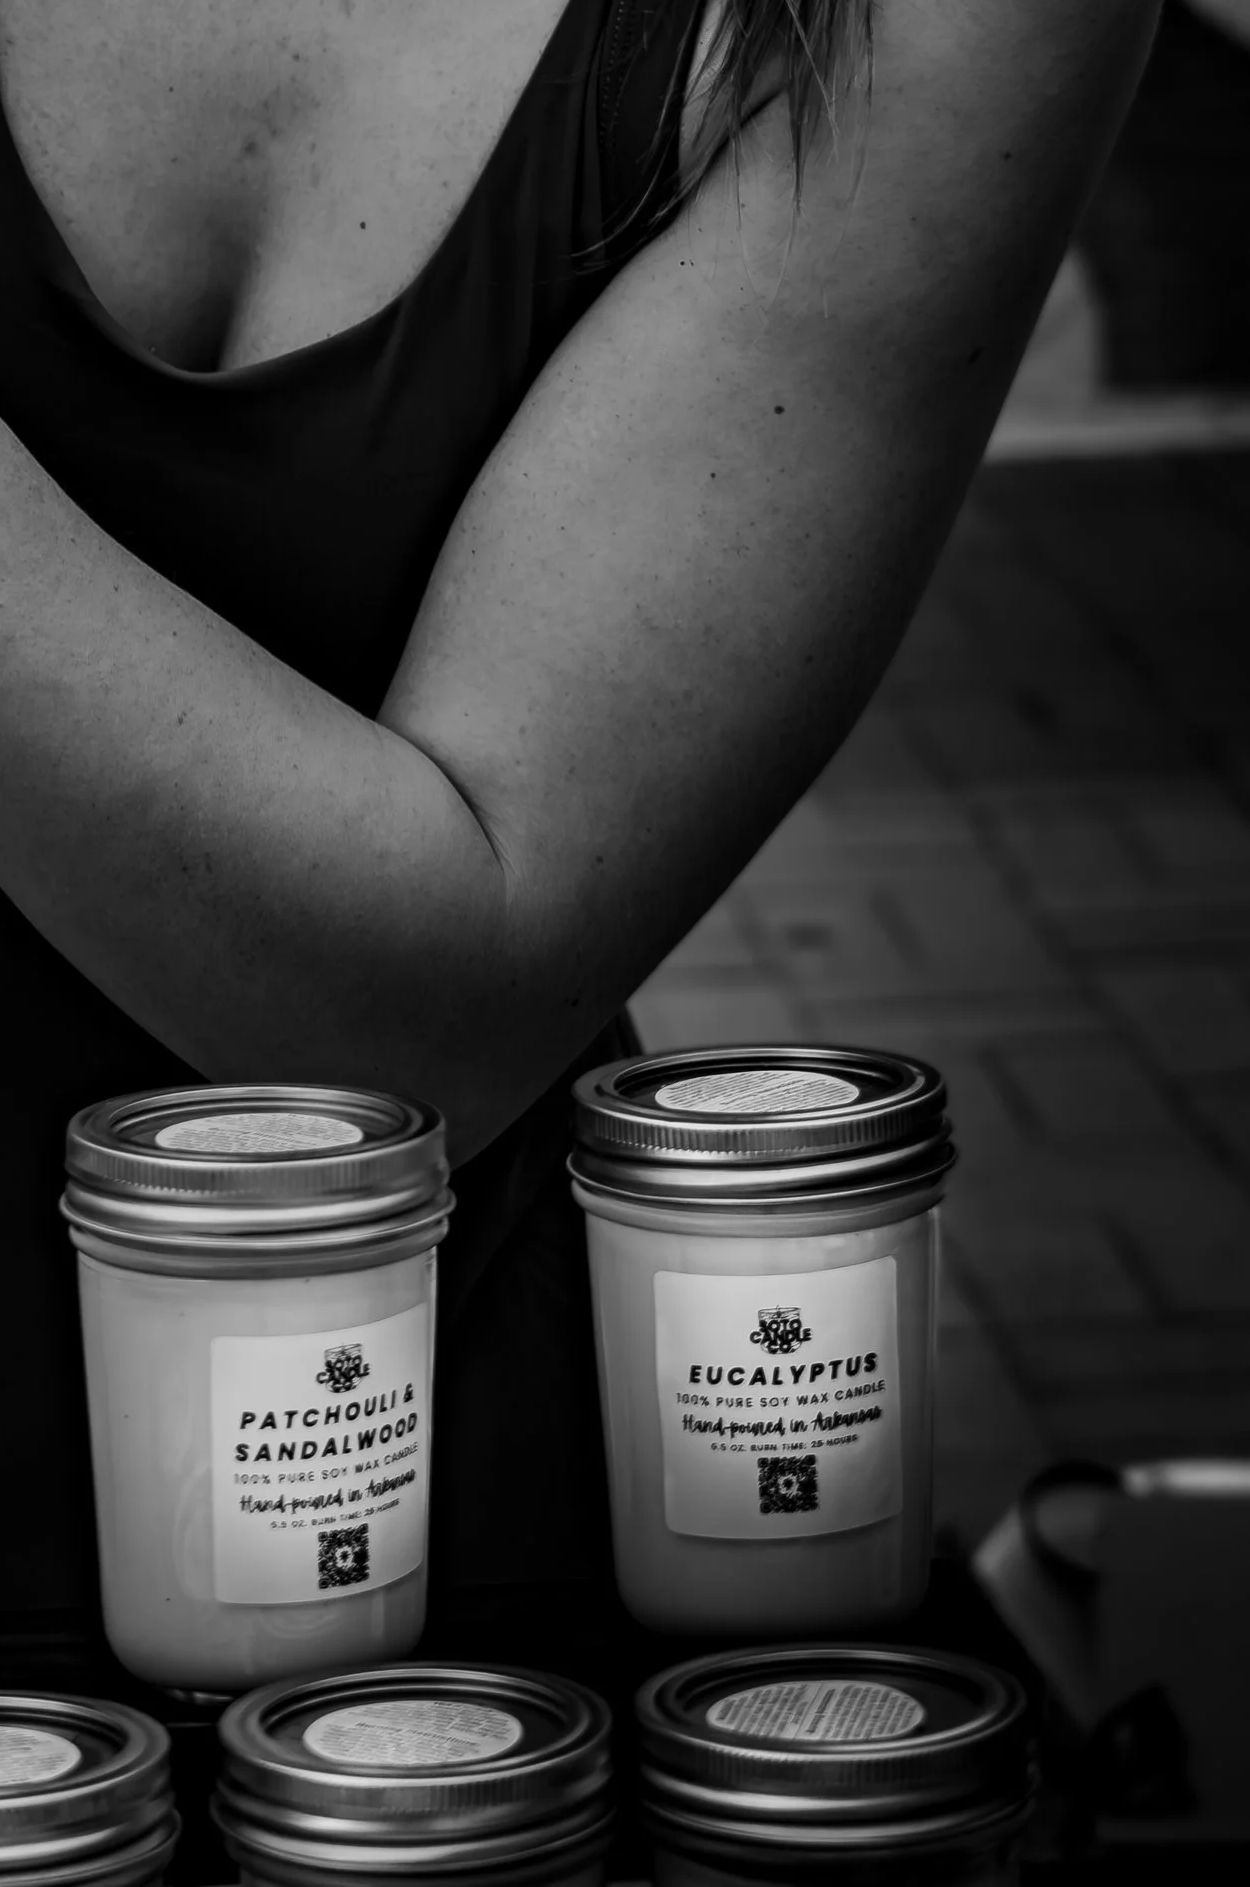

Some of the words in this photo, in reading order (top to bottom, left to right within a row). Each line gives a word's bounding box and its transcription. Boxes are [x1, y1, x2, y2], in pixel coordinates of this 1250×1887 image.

[688, 1352, 878, 1385] EUCALYPTUS
[239, 1389, 397, 1430] PATCHOULI
[403, 1382, 414, 1403] &
[677, 1392, 710, 1406] 100%
[716, 1397, 753, 1408] PURE
[760, 1397, 789, 1408] SOY
[797, 1392, 829, 1406] WAX
[834, 1379, 886, 1401] CANDLE
[234, 1412, 418, 1462] SANDALWOOD
[682, 1414, 785, 1439] Hand-poured
[790, 1419, 808, 1433] in
[810, 1405, 883, 1431] Arkansas
